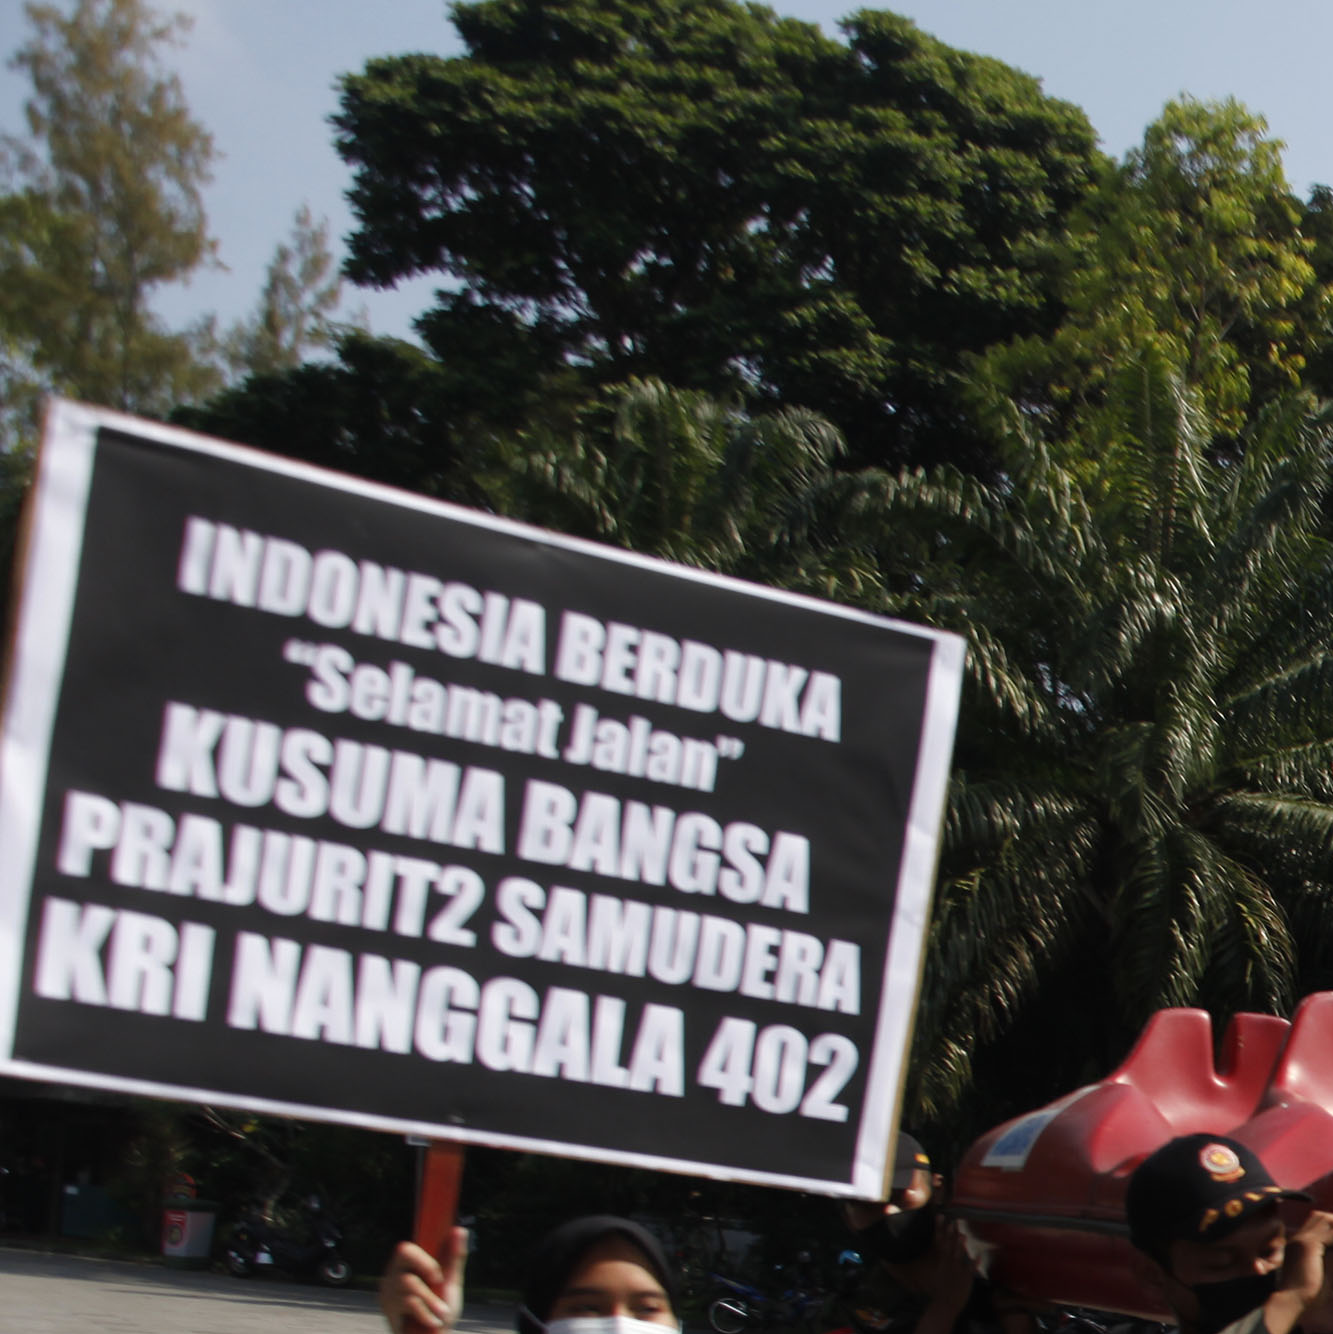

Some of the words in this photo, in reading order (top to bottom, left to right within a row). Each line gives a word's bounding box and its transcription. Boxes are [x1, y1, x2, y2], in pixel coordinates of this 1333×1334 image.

[180, 517, 545, 674] INDONESIA
[556, 612, 842, 742] BERDUKA
[57, 790, 486, 948] PRAJURIT2
[492, 878, 862, 1015] SAMUDERA
[156, 701, 505, 855] KUSUMA
[519, 780, 810, 914] BANGSA
[34, 896, 215, 1022] KRI
[227, 932, 686, 1098] NANGGALA
[698, 1017, 860, 1122] 402
